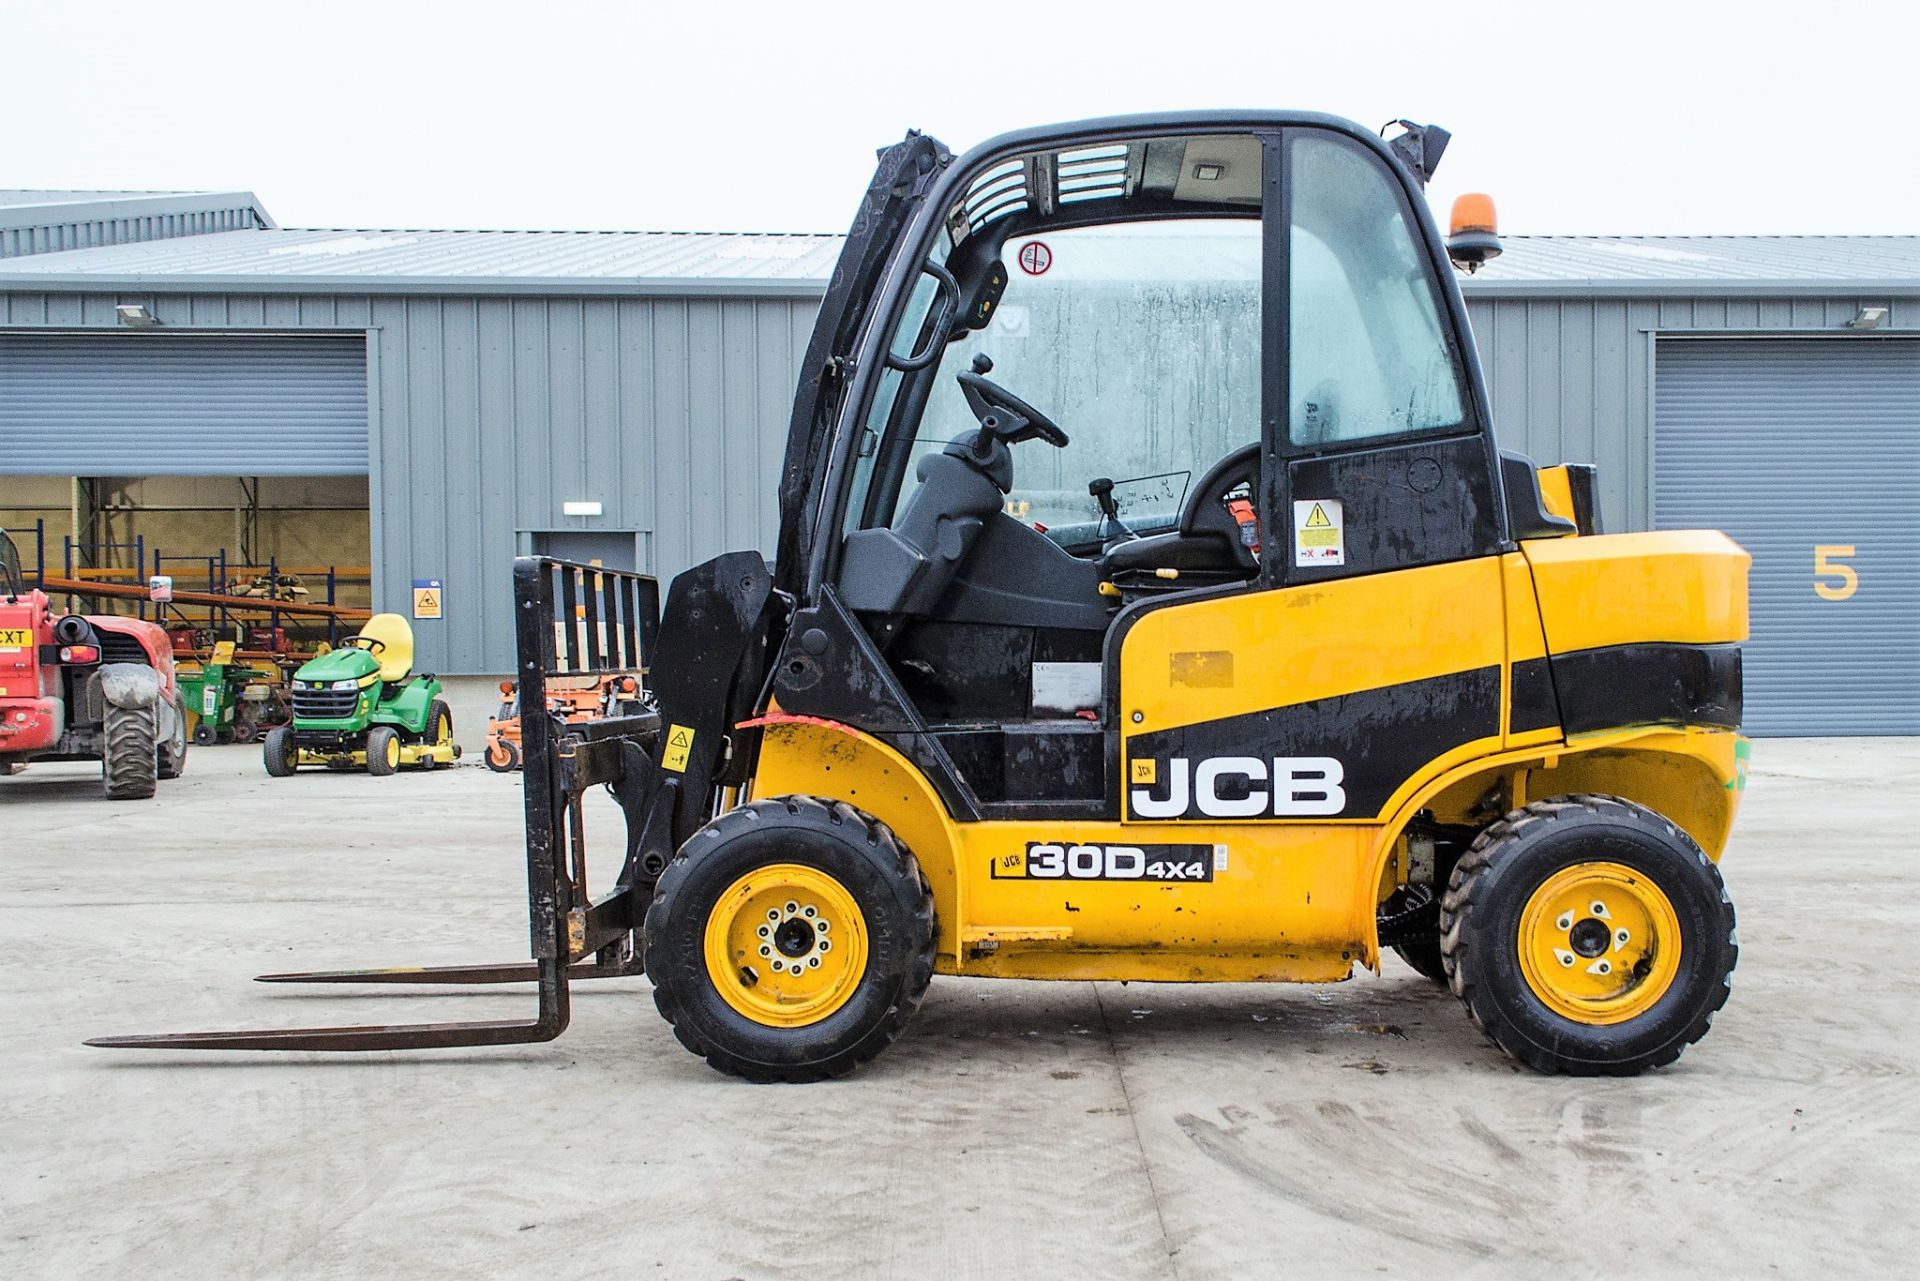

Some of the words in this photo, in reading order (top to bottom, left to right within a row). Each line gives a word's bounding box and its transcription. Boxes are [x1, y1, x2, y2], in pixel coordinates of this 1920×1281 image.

[1814, 546, 1858, 600] 5
[1131, 756, 1346, 818] JCB
[1003, 855, 1020, 868] JCB
[1029, 846, 1145, 878] 30D
